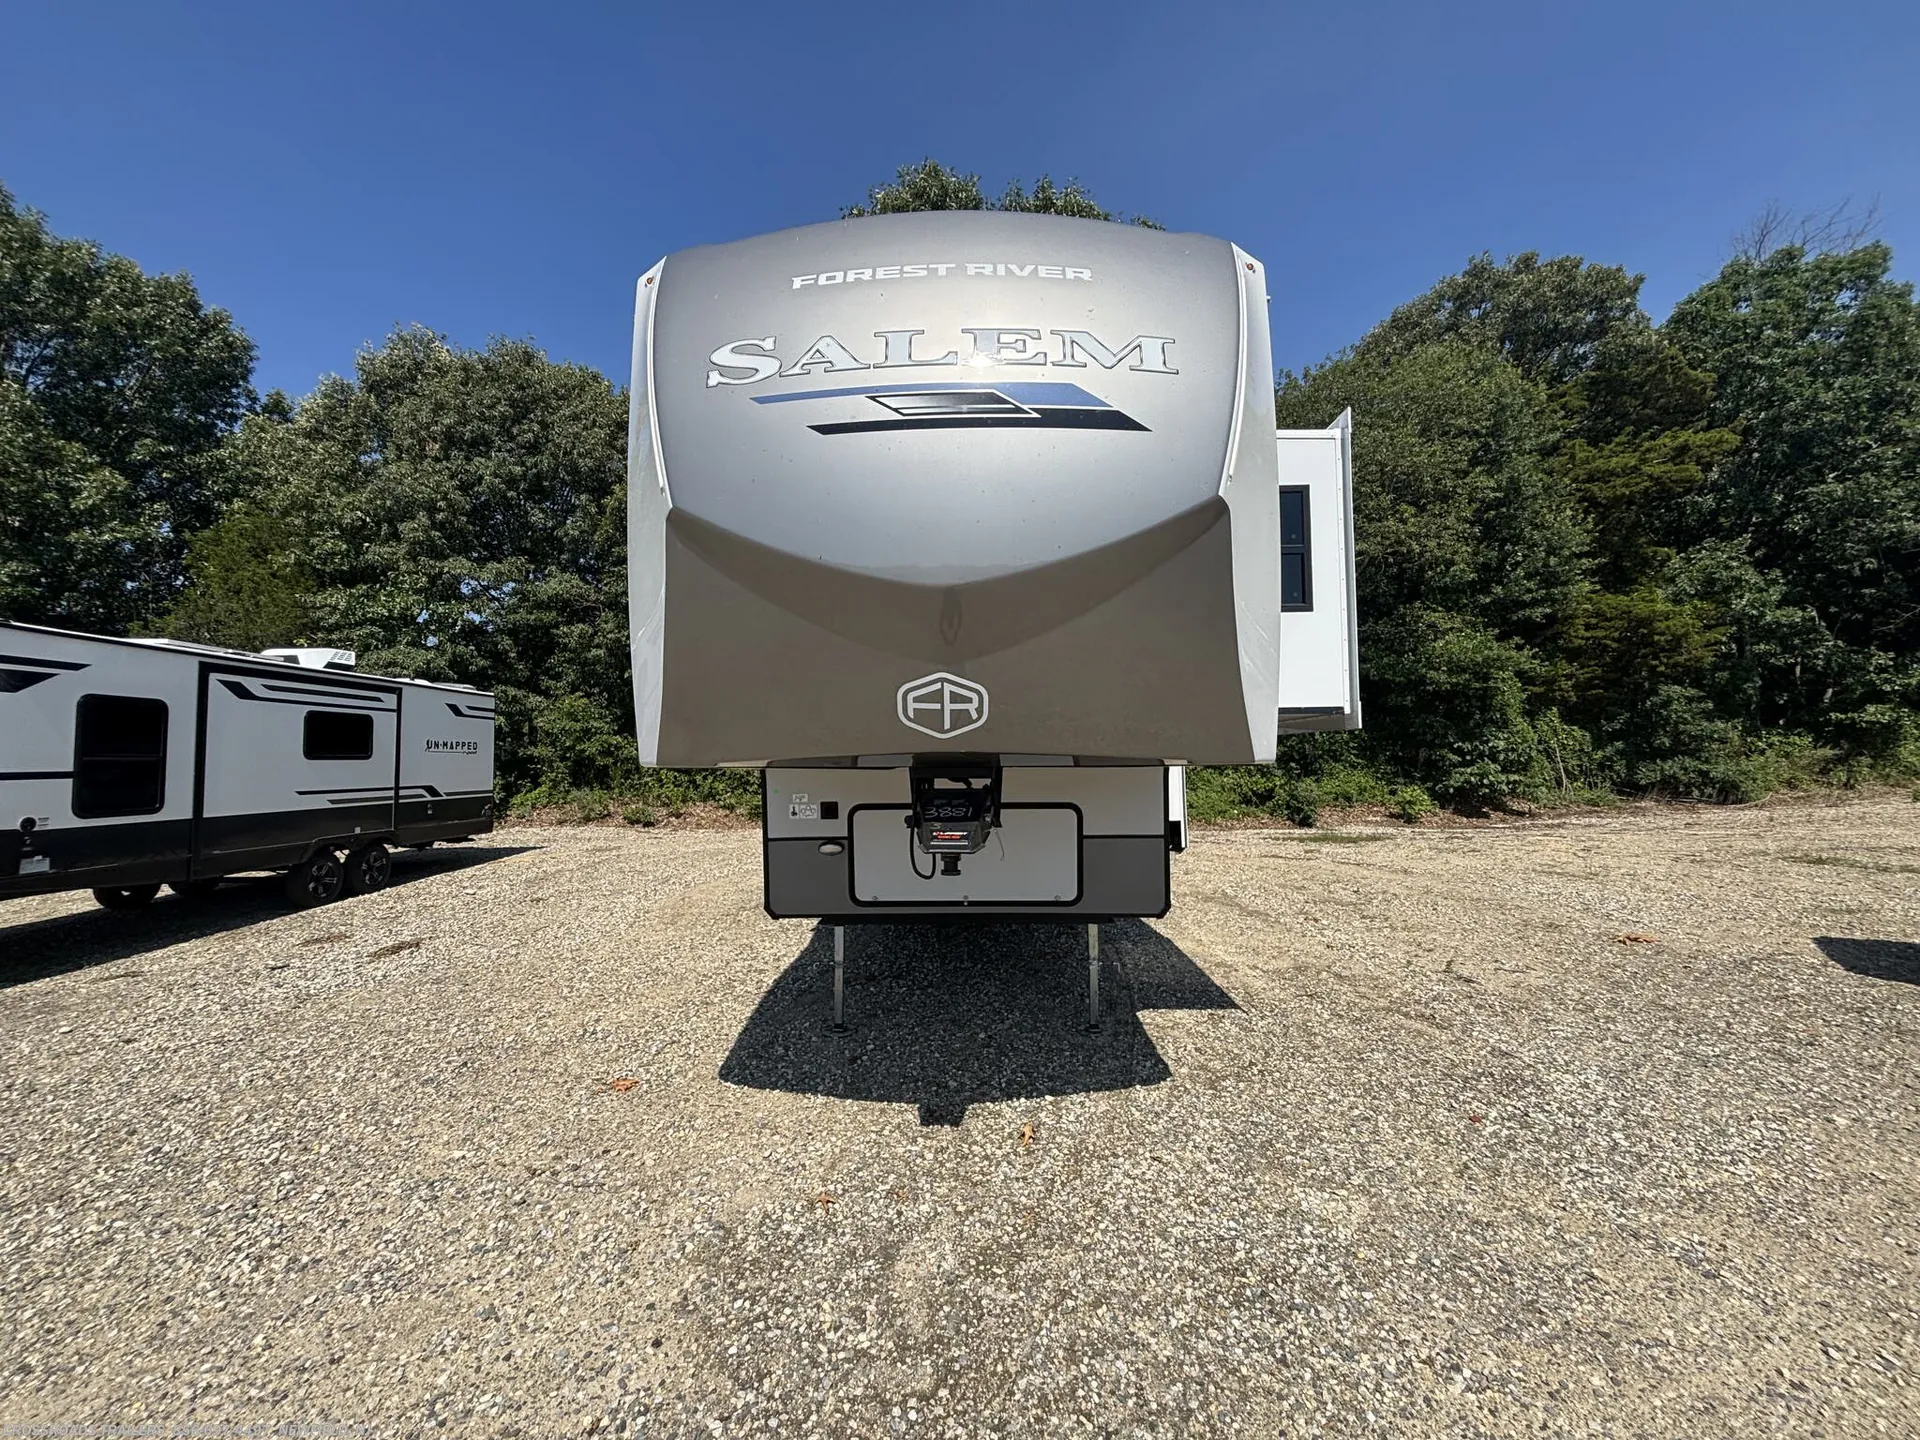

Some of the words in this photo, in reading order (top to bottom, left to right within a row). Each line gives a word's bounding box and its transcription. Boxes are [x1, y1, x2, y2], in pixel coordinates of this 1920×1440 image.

[791, 263, 956, 289] FOREST
[965, 263, 1093, 281] RIVER
[706, 328, 1179, 387] SALEM
